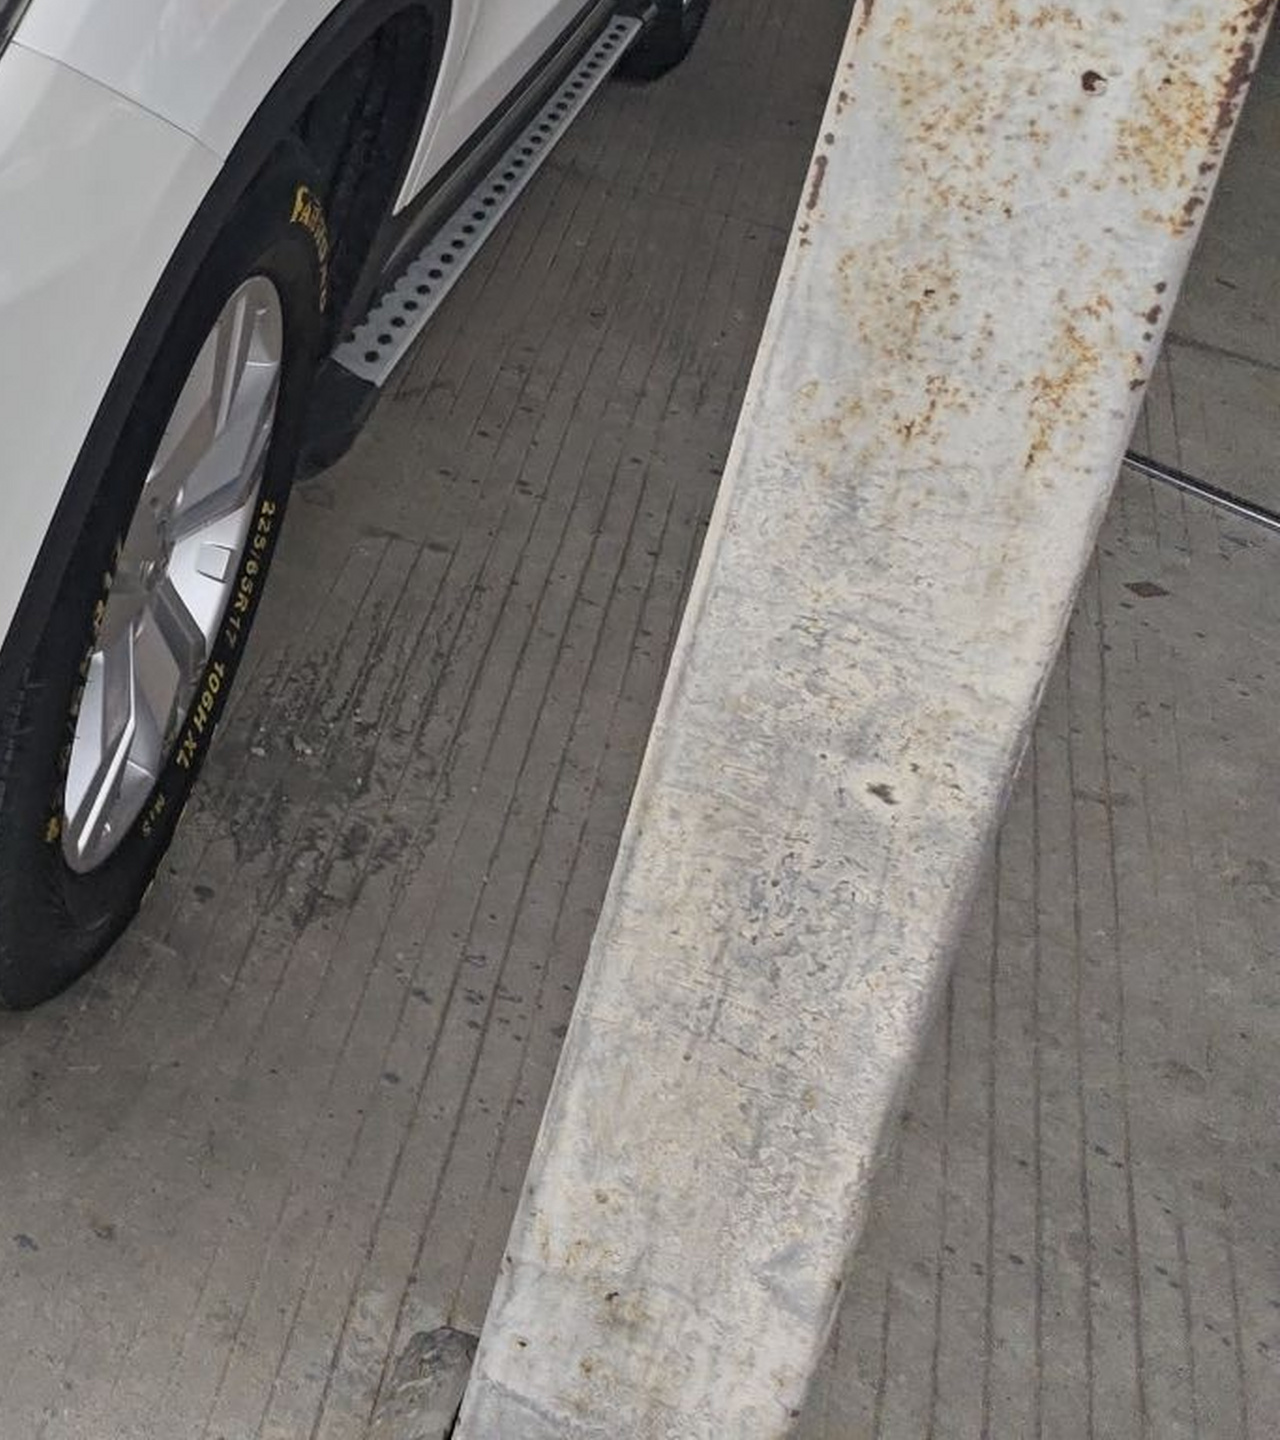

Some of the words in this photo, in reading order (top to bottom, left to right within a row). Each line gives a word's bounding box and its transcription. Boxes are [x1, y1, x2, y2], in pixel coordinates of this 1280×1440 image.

[225, 500, 276, 647] 225/65R17
[193, 662, 225, 728] 106H
[176, 730, 199, 767] XL
